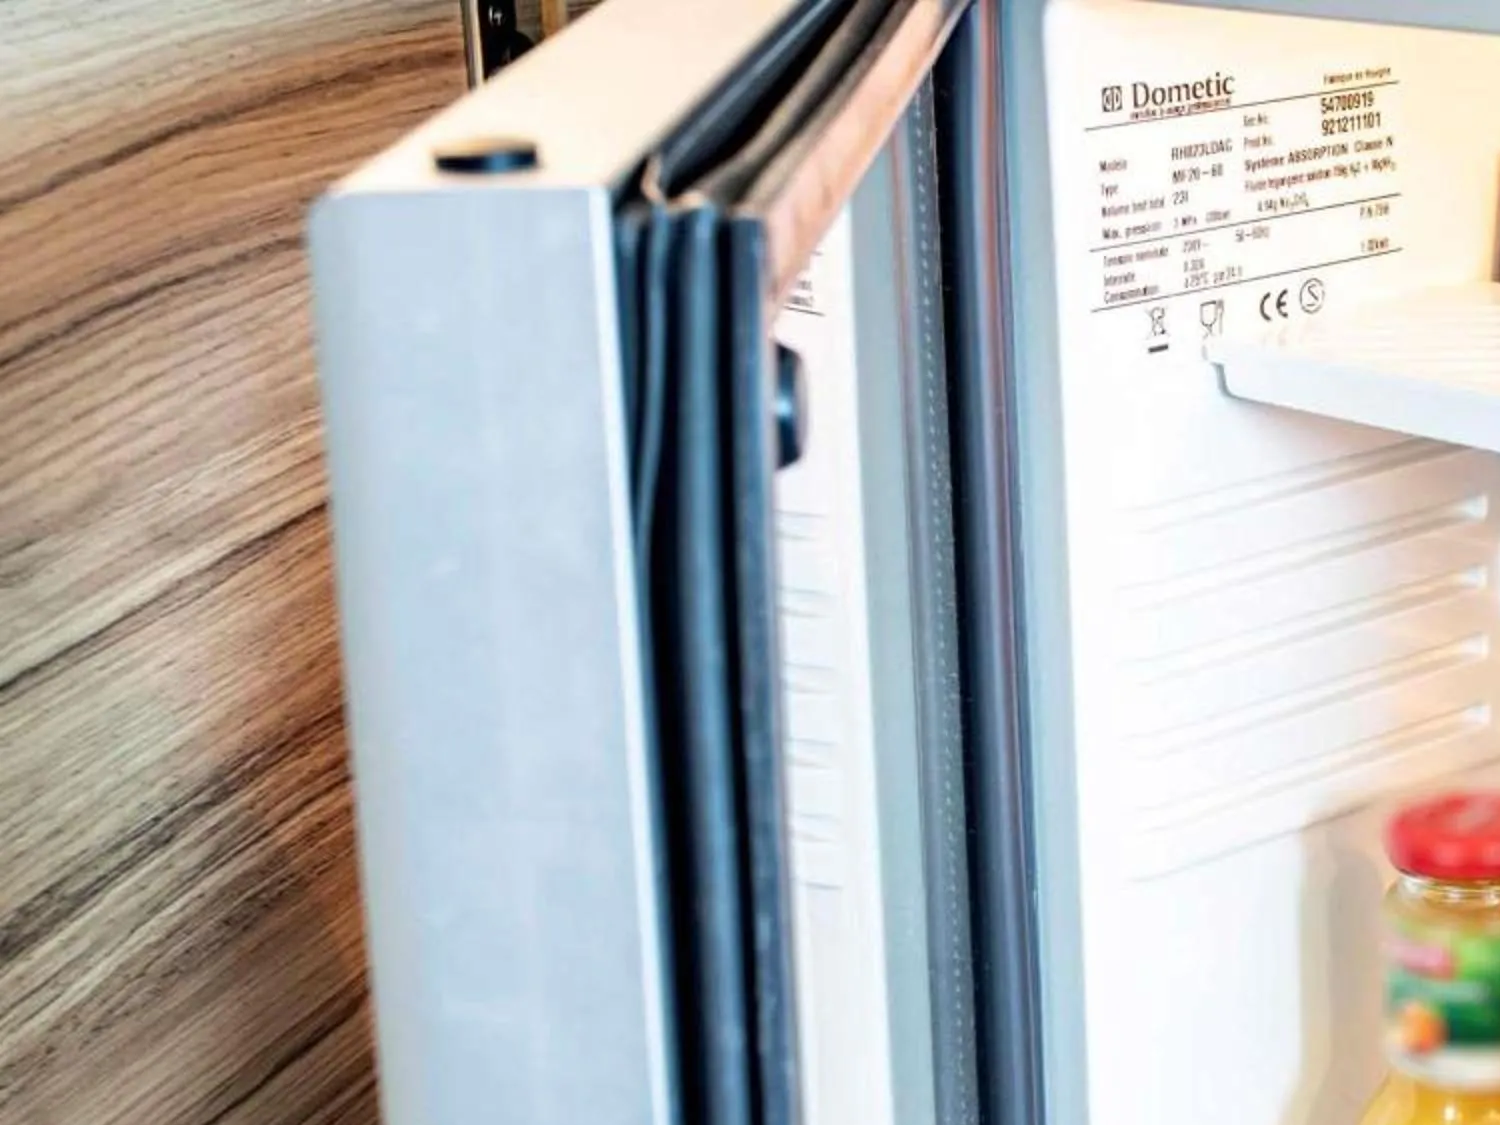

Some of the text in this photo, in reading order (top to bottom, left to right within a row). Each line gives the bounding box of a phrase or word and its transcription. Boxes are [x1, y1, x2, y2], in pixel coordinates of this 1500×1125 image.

[1132, 71, 1235, 109] Dometic
[1320, 91, 1375, 115] 54700919
[1321, 111, 1382, 136] 921211101
[1287, 142, 1349, 164] ABSORPTION
